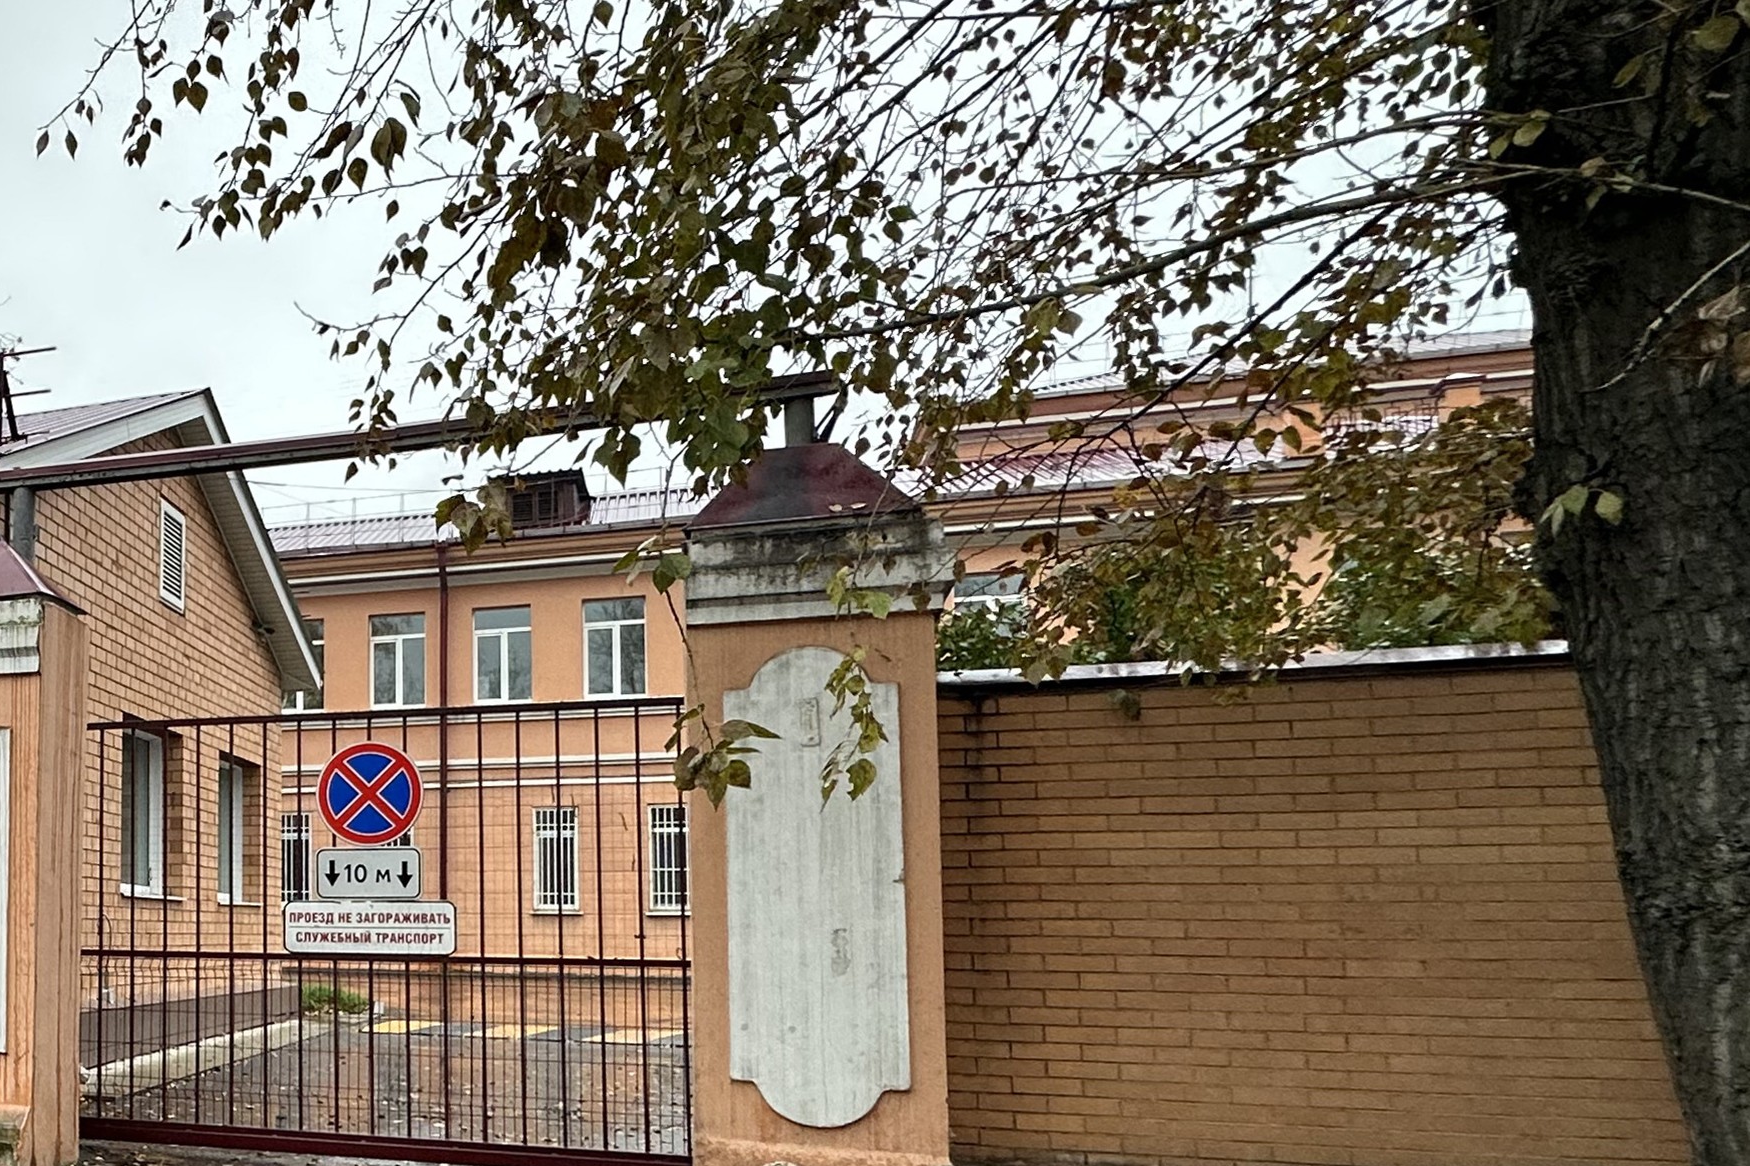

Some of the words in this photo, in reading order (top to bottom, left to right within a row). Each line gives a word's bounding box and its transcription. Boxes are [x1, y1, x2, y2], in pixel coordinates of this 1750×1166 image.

[343, 863, 368, 883] 10
[289, 912, 334, 925] ПРОЕЗД
[338, 912, 353, 924] НЕ
[356, 912, 451, 925] ЗАГОРАЖИВАТЬ
[295, 930, 372, 944] СЛУЖЕБНЫЙ
[376, 932, 444, 945] ТРАНСПОРТ
